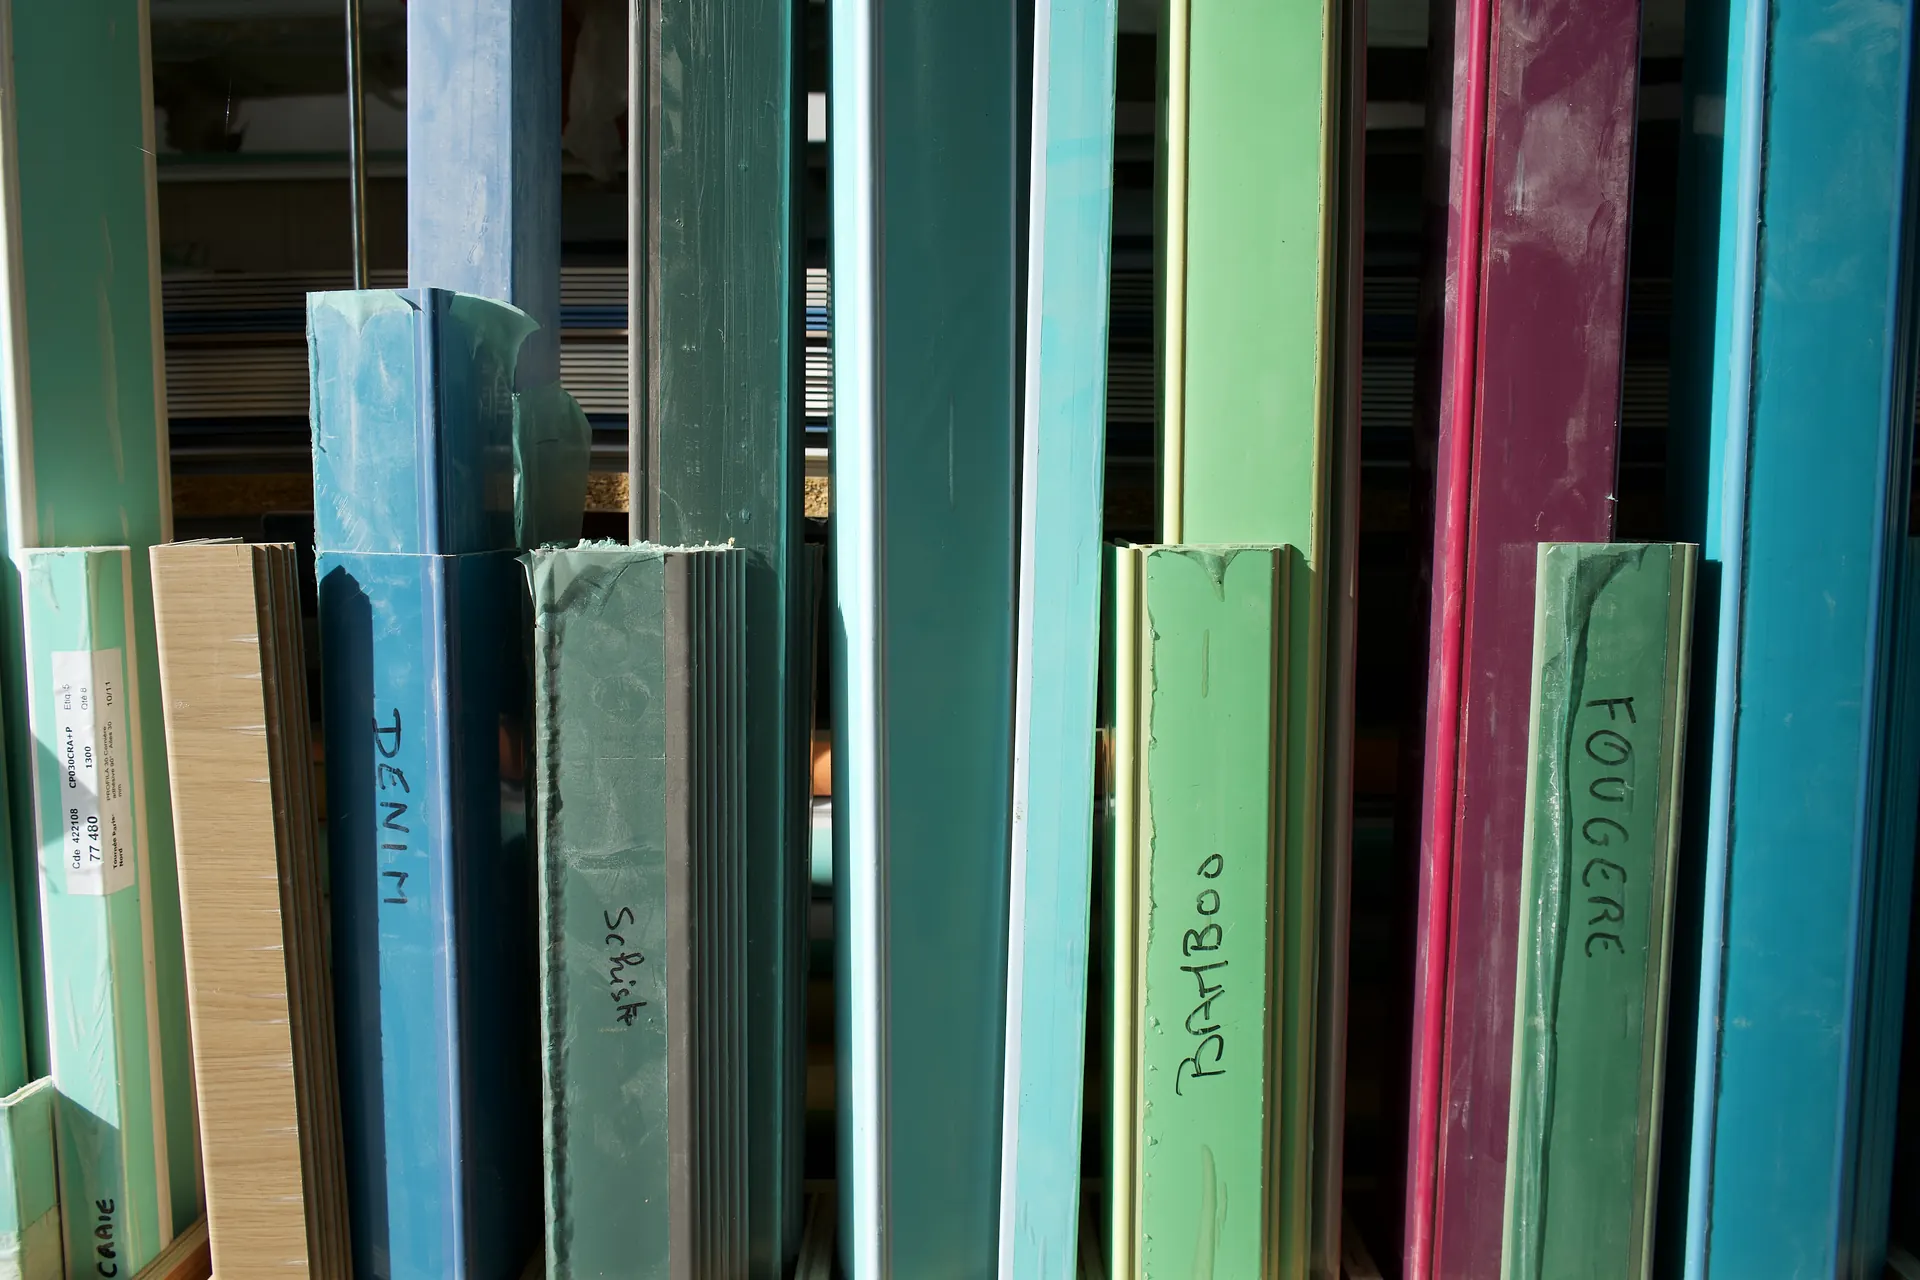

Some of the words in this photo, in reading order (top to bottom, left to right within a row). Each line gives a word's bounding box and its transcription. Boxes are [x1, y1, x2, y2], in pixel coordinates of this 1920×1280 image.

[105, 681, 113, 706] 10/11
[65, 726, 76, 788] CP030CRA+P
[84, 746, 93, 769] 1300
[372, 707, 410, 905] DENIM
[70, 808, 80, 843] 422108
[87, 816, 99, 841] 480
[1582, 696, 1636, 958] FOUGERE
[72, 849, 81, 869] Cde
[89, 845, 101, 862] 77
[1175, 853, 1229, 1096] BAMBOO
